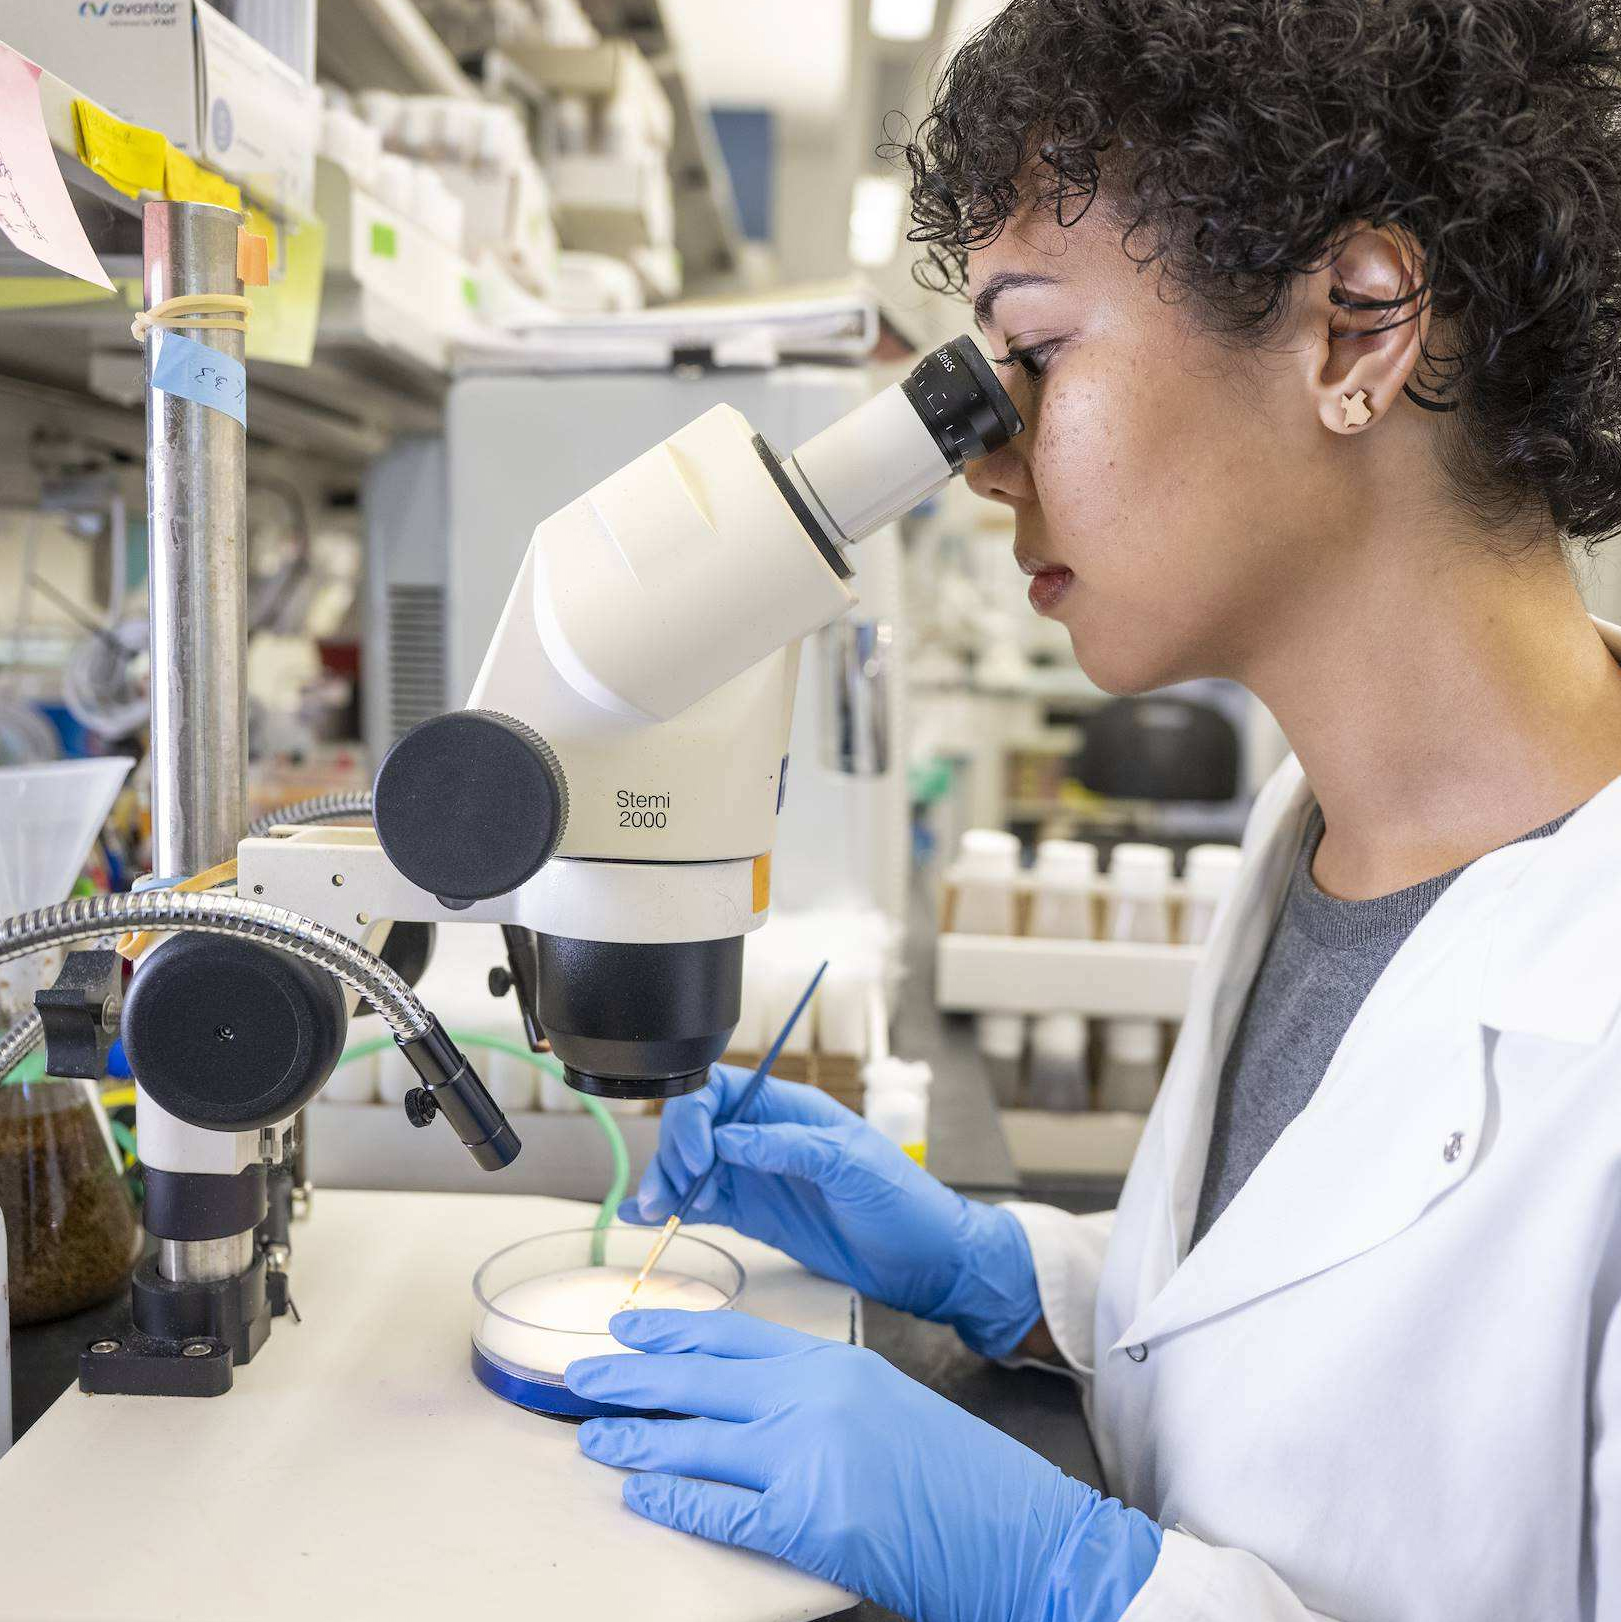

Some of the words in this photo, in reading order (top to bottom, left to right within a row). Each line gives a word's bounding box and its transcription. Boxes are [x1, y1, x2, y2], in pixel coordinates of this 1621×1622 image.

[111, 1, 176, 15] avantor
[616, 790, 670, 809] Stemi
[619, 810, 667, 829] 2000
